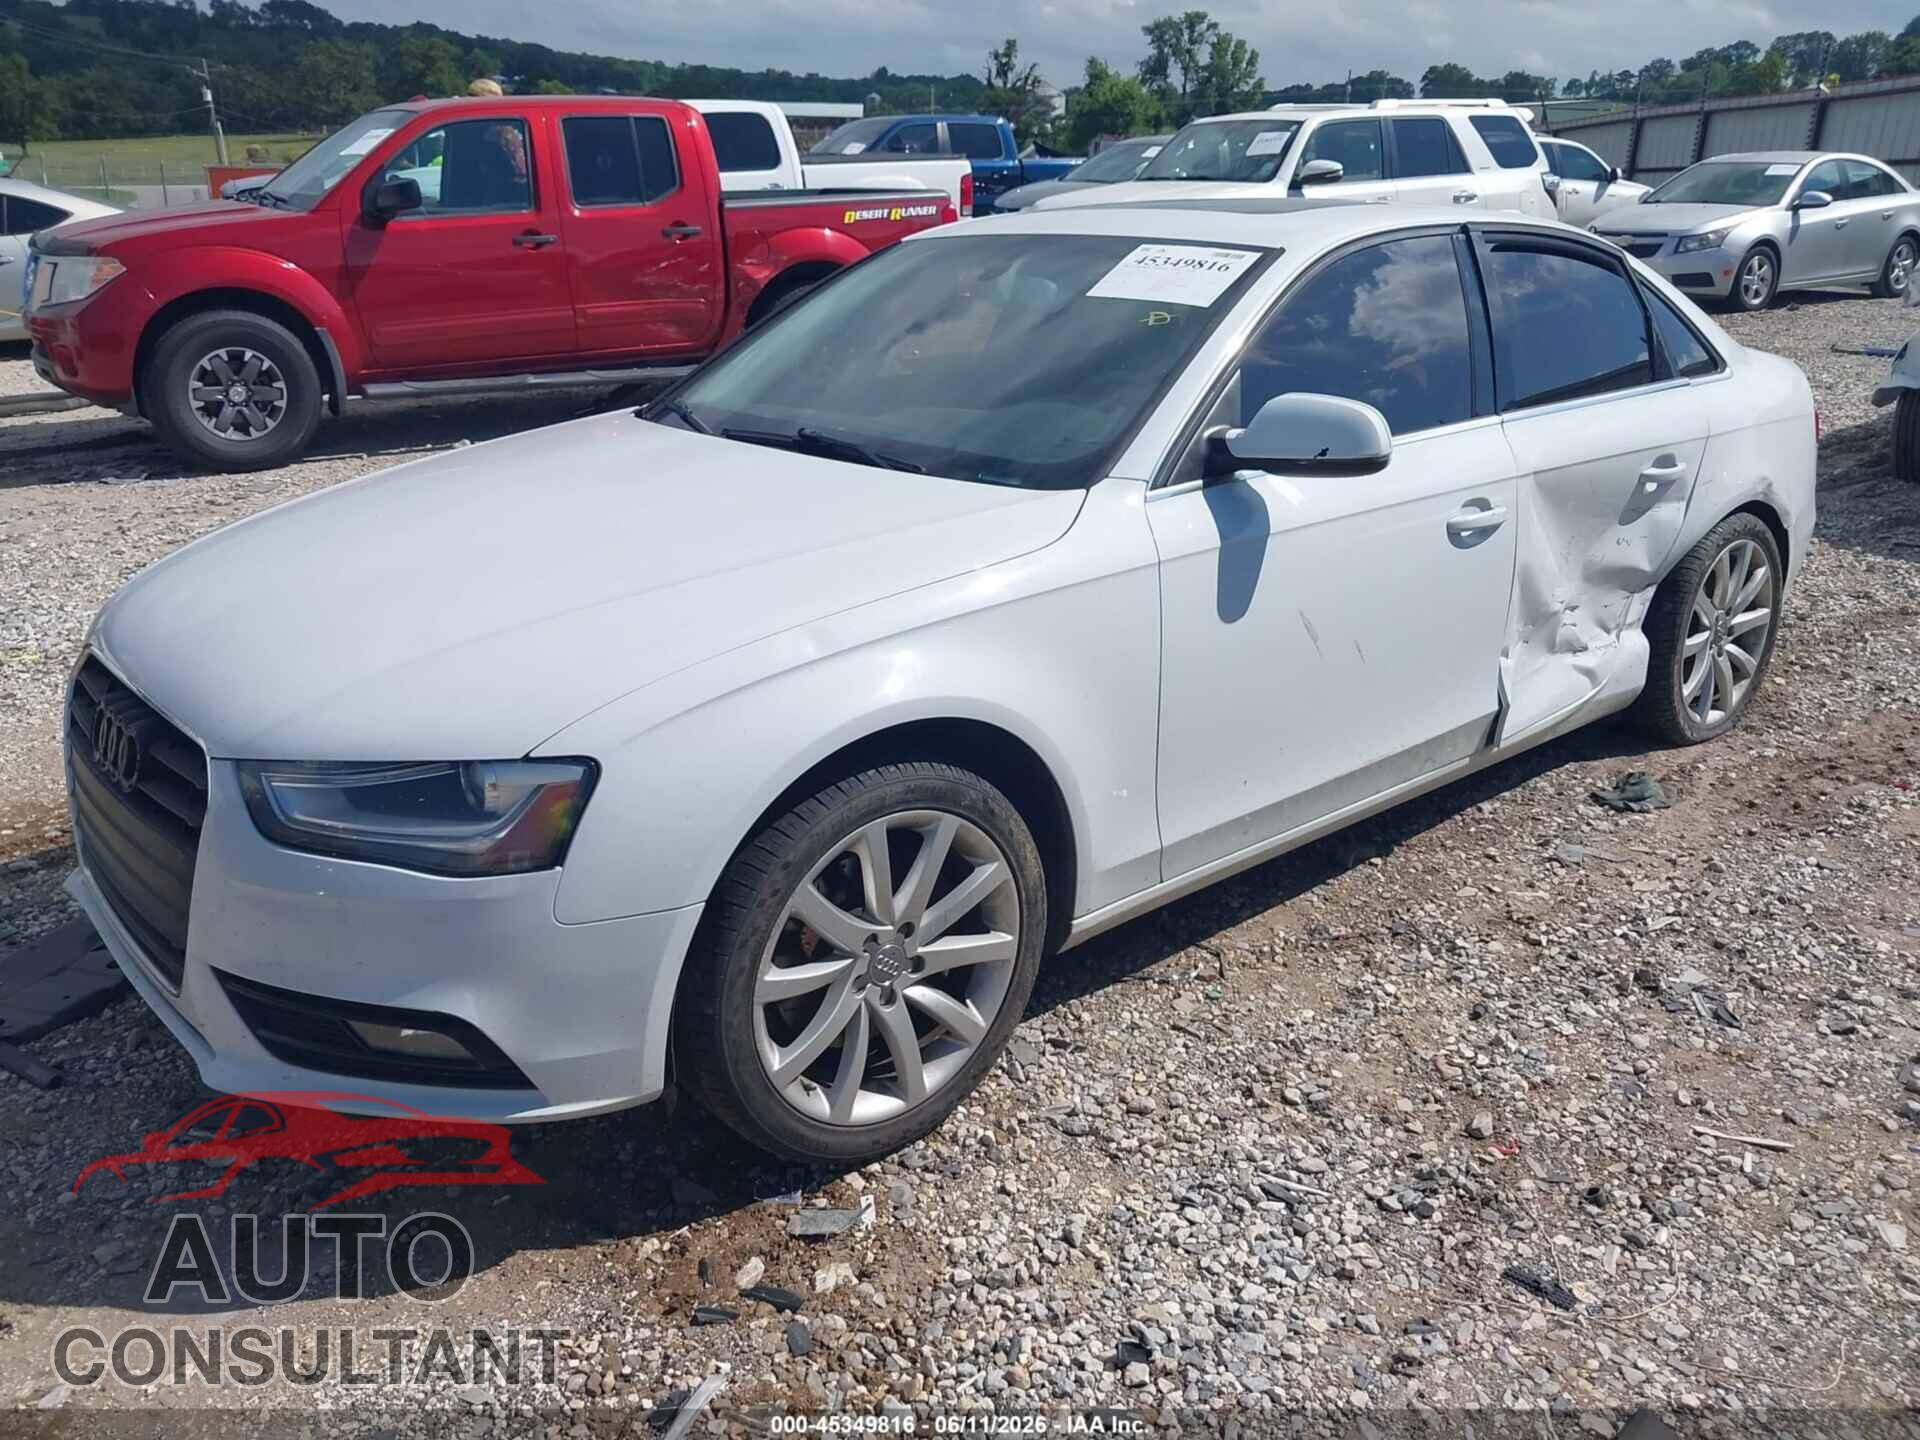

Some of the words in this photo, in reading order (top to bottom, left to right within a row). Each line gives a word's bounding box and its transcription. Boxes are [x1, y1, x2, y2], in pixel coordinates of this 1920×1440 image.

[843, 208, 889, 224] DESERT
[890, 205, 937, 221] RUNNER
[1134, 255, 1231, 272] 45349816
